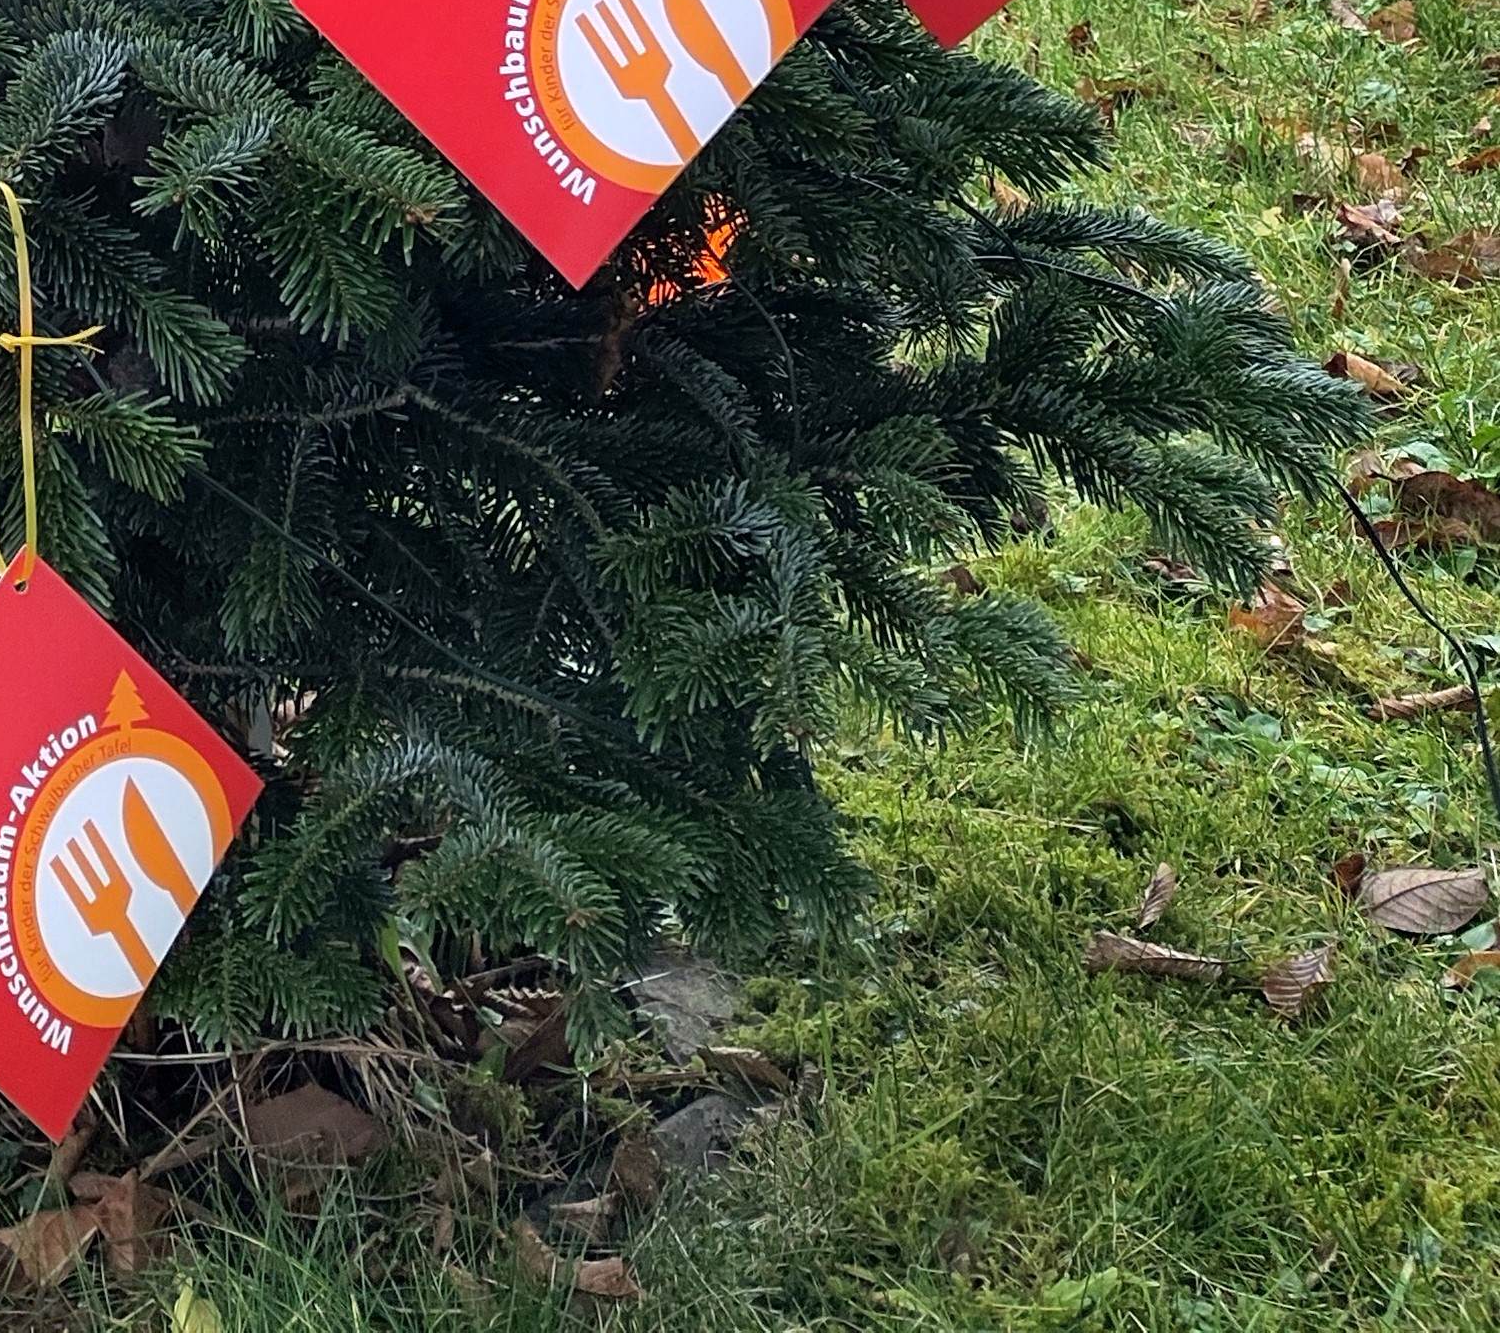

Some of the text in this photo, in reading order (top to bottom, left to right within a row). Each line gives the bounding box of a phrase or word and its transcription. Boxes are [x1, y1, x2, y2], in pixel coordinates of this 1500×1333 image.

[542, 17, 556, 42] der
[539, 49, 562, 104] Kinder
[100, 736, 132, 759] Tafel
[24, 752, 97, 856] Schwalbacher
[21, 862, 34, 891] der
[21, 899, 41, 956] Kinder
